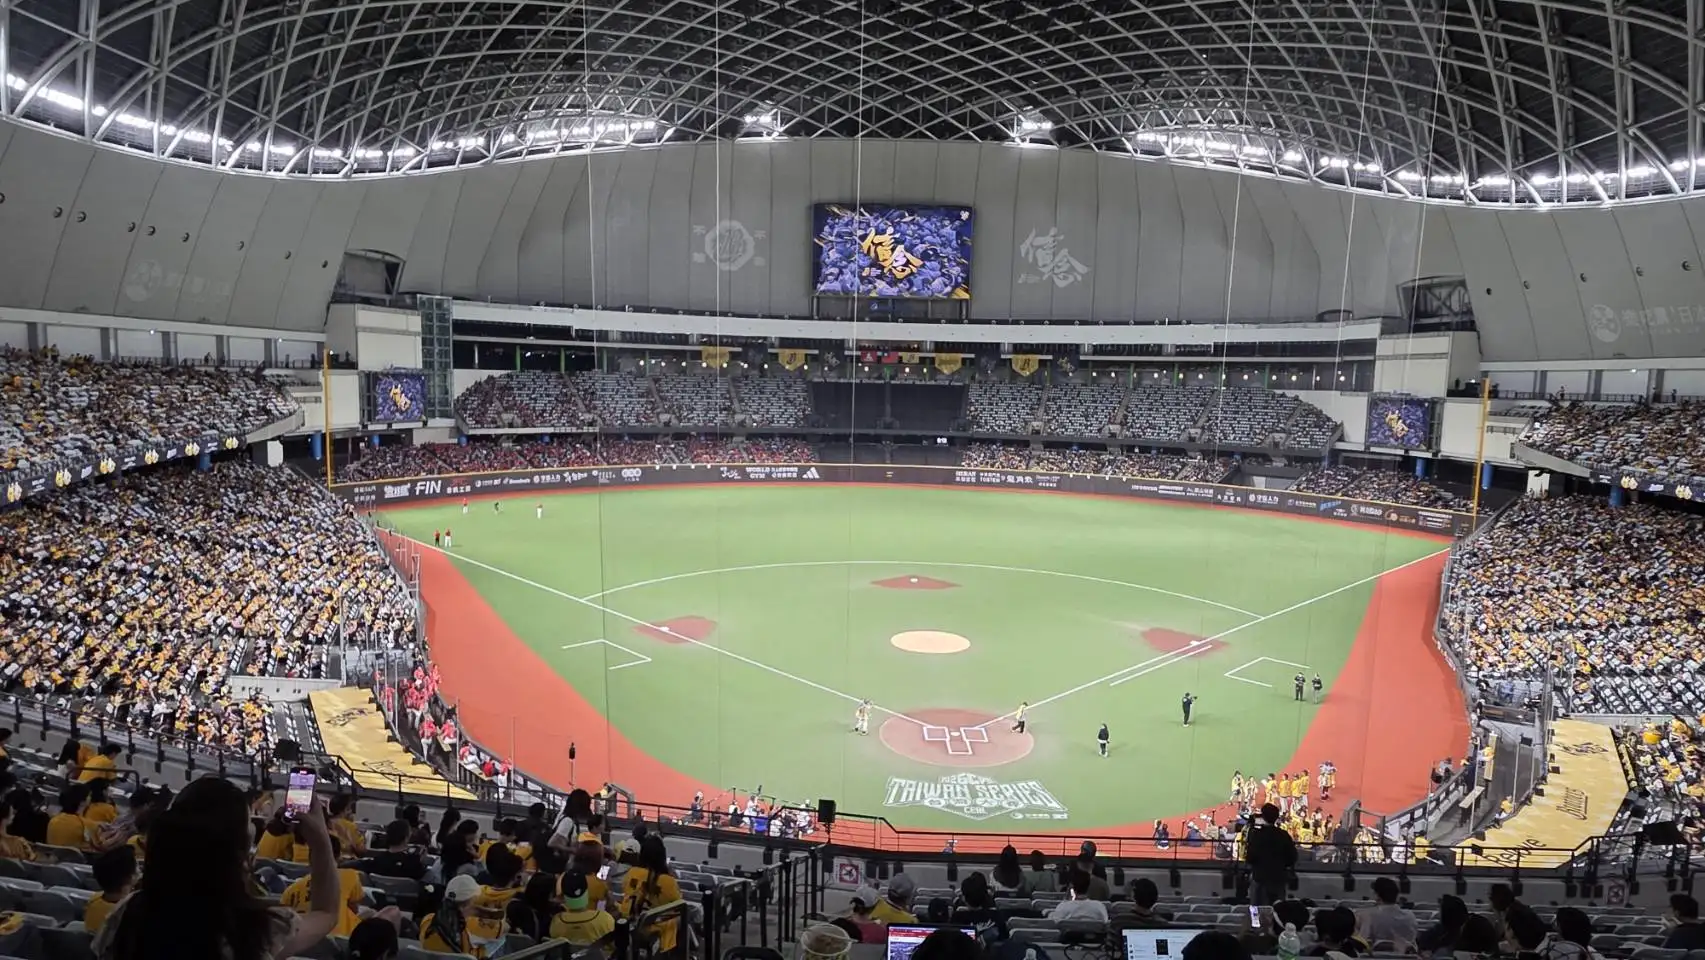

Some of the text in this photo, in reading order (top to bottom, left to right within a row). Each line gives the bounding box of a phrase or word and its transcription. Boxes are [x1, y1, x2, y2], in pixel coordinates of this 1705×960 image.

[415, 480, 442, 495] FIN
[886, 777, 1063, 810] TAIWAN SERIES
